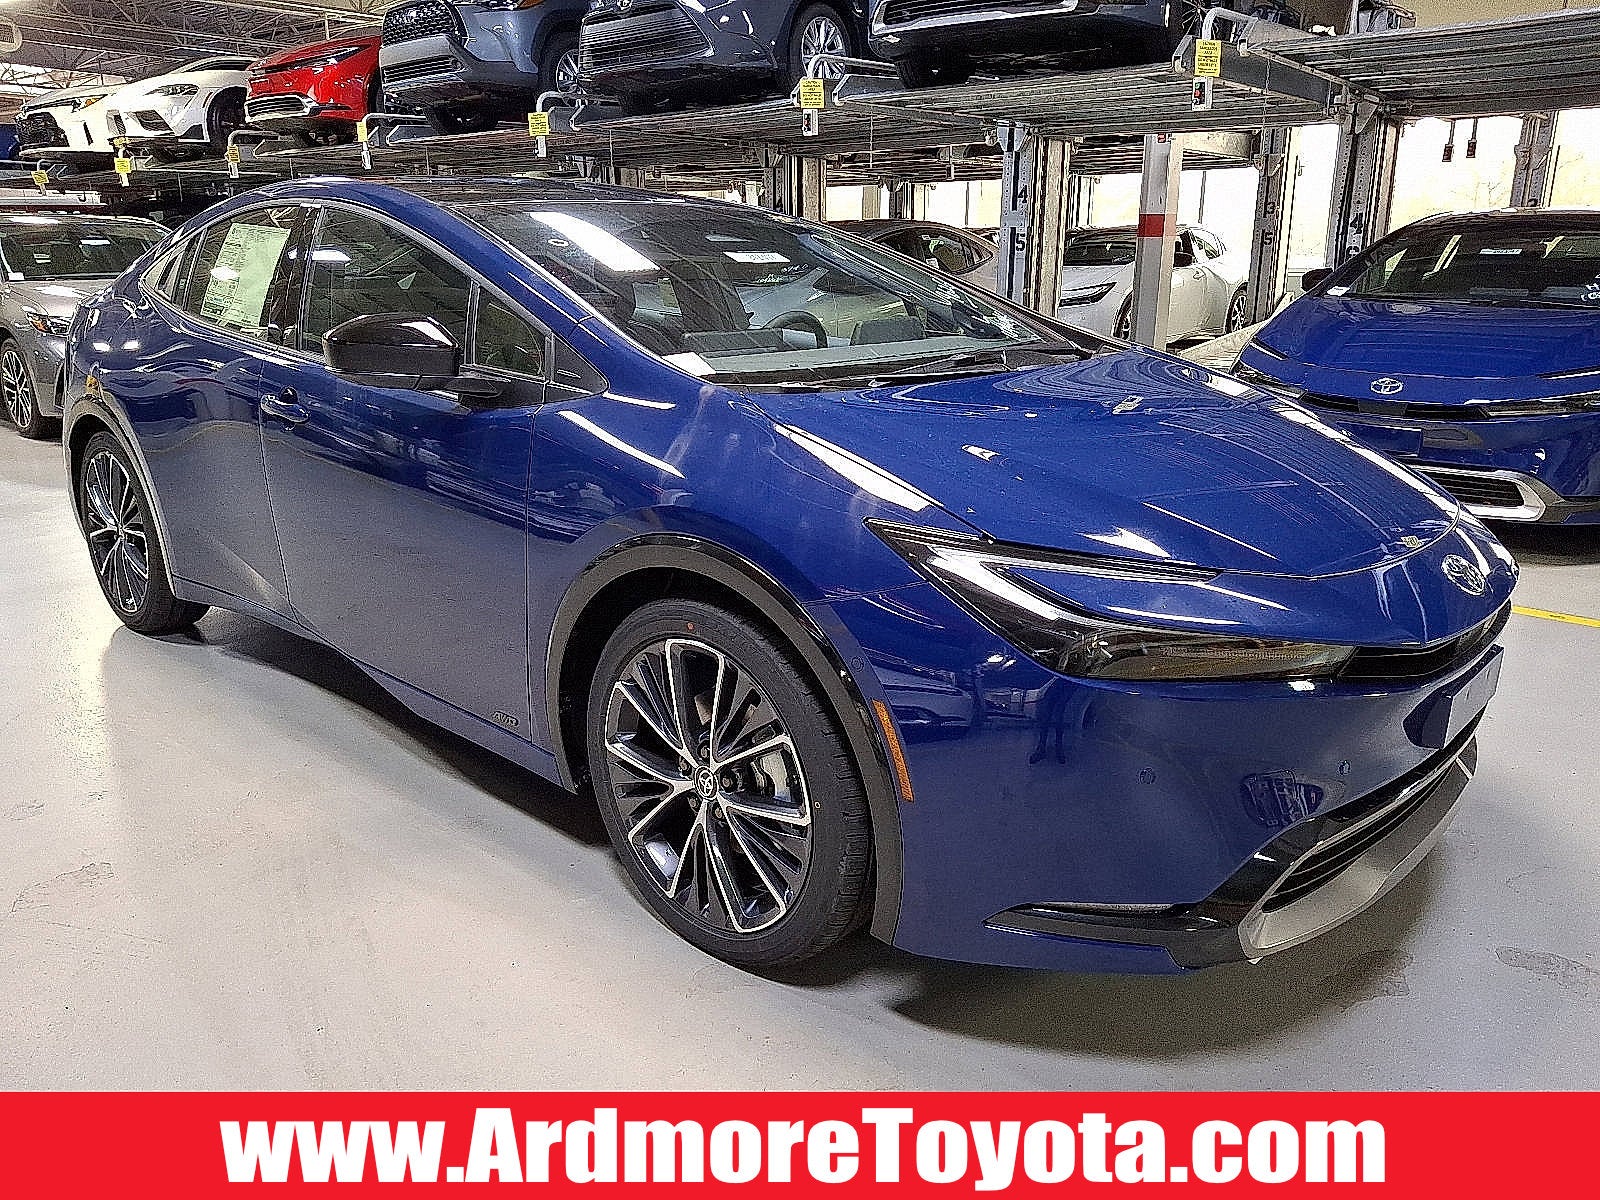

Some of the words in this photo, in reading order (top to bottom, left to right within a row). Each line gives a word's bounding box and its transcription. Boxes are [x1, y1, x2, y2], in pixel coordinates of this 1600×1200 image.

[1018, 185, 1028, 204] 4
[1350, 213, 1363, 235] 4
[1015, 233, 1026, 252] 5
